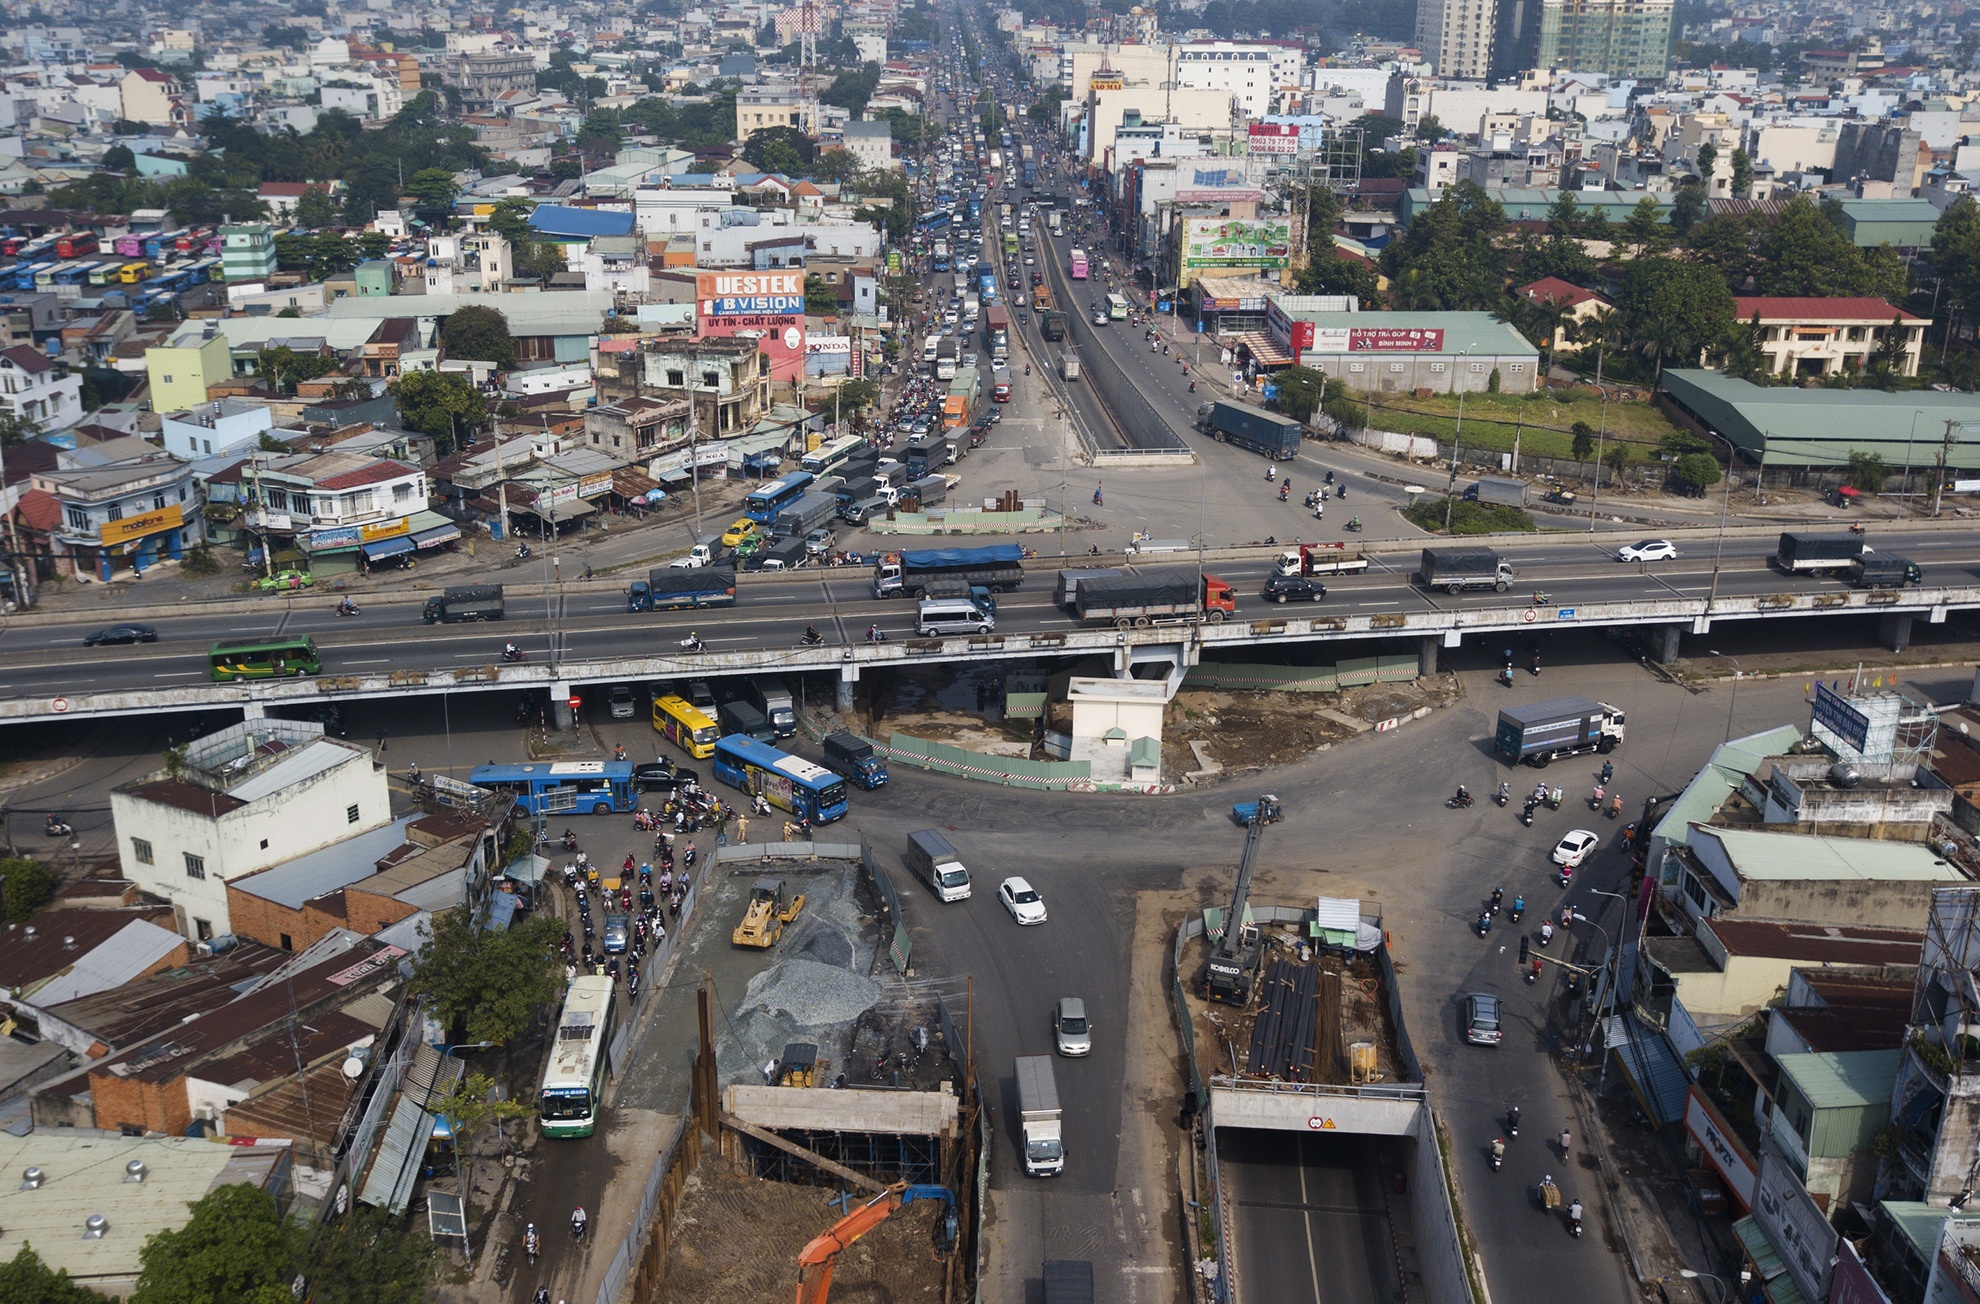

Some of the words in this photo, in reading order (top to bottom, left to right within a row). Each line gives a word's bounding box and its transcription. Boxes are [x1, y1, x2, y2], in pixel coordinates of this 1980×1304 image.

[708, 319, 720, 327] UY
[723, 317, 736, 327] TÍN
[743, 316, 765, 326] CHẤT
[768, 317, 796, 327] LƯỢNG
[122, 515, 164, 532] mobifone
[1832, 709, 1842, 724] THI
[1211, 963, 1239, 974] KOBELCO
